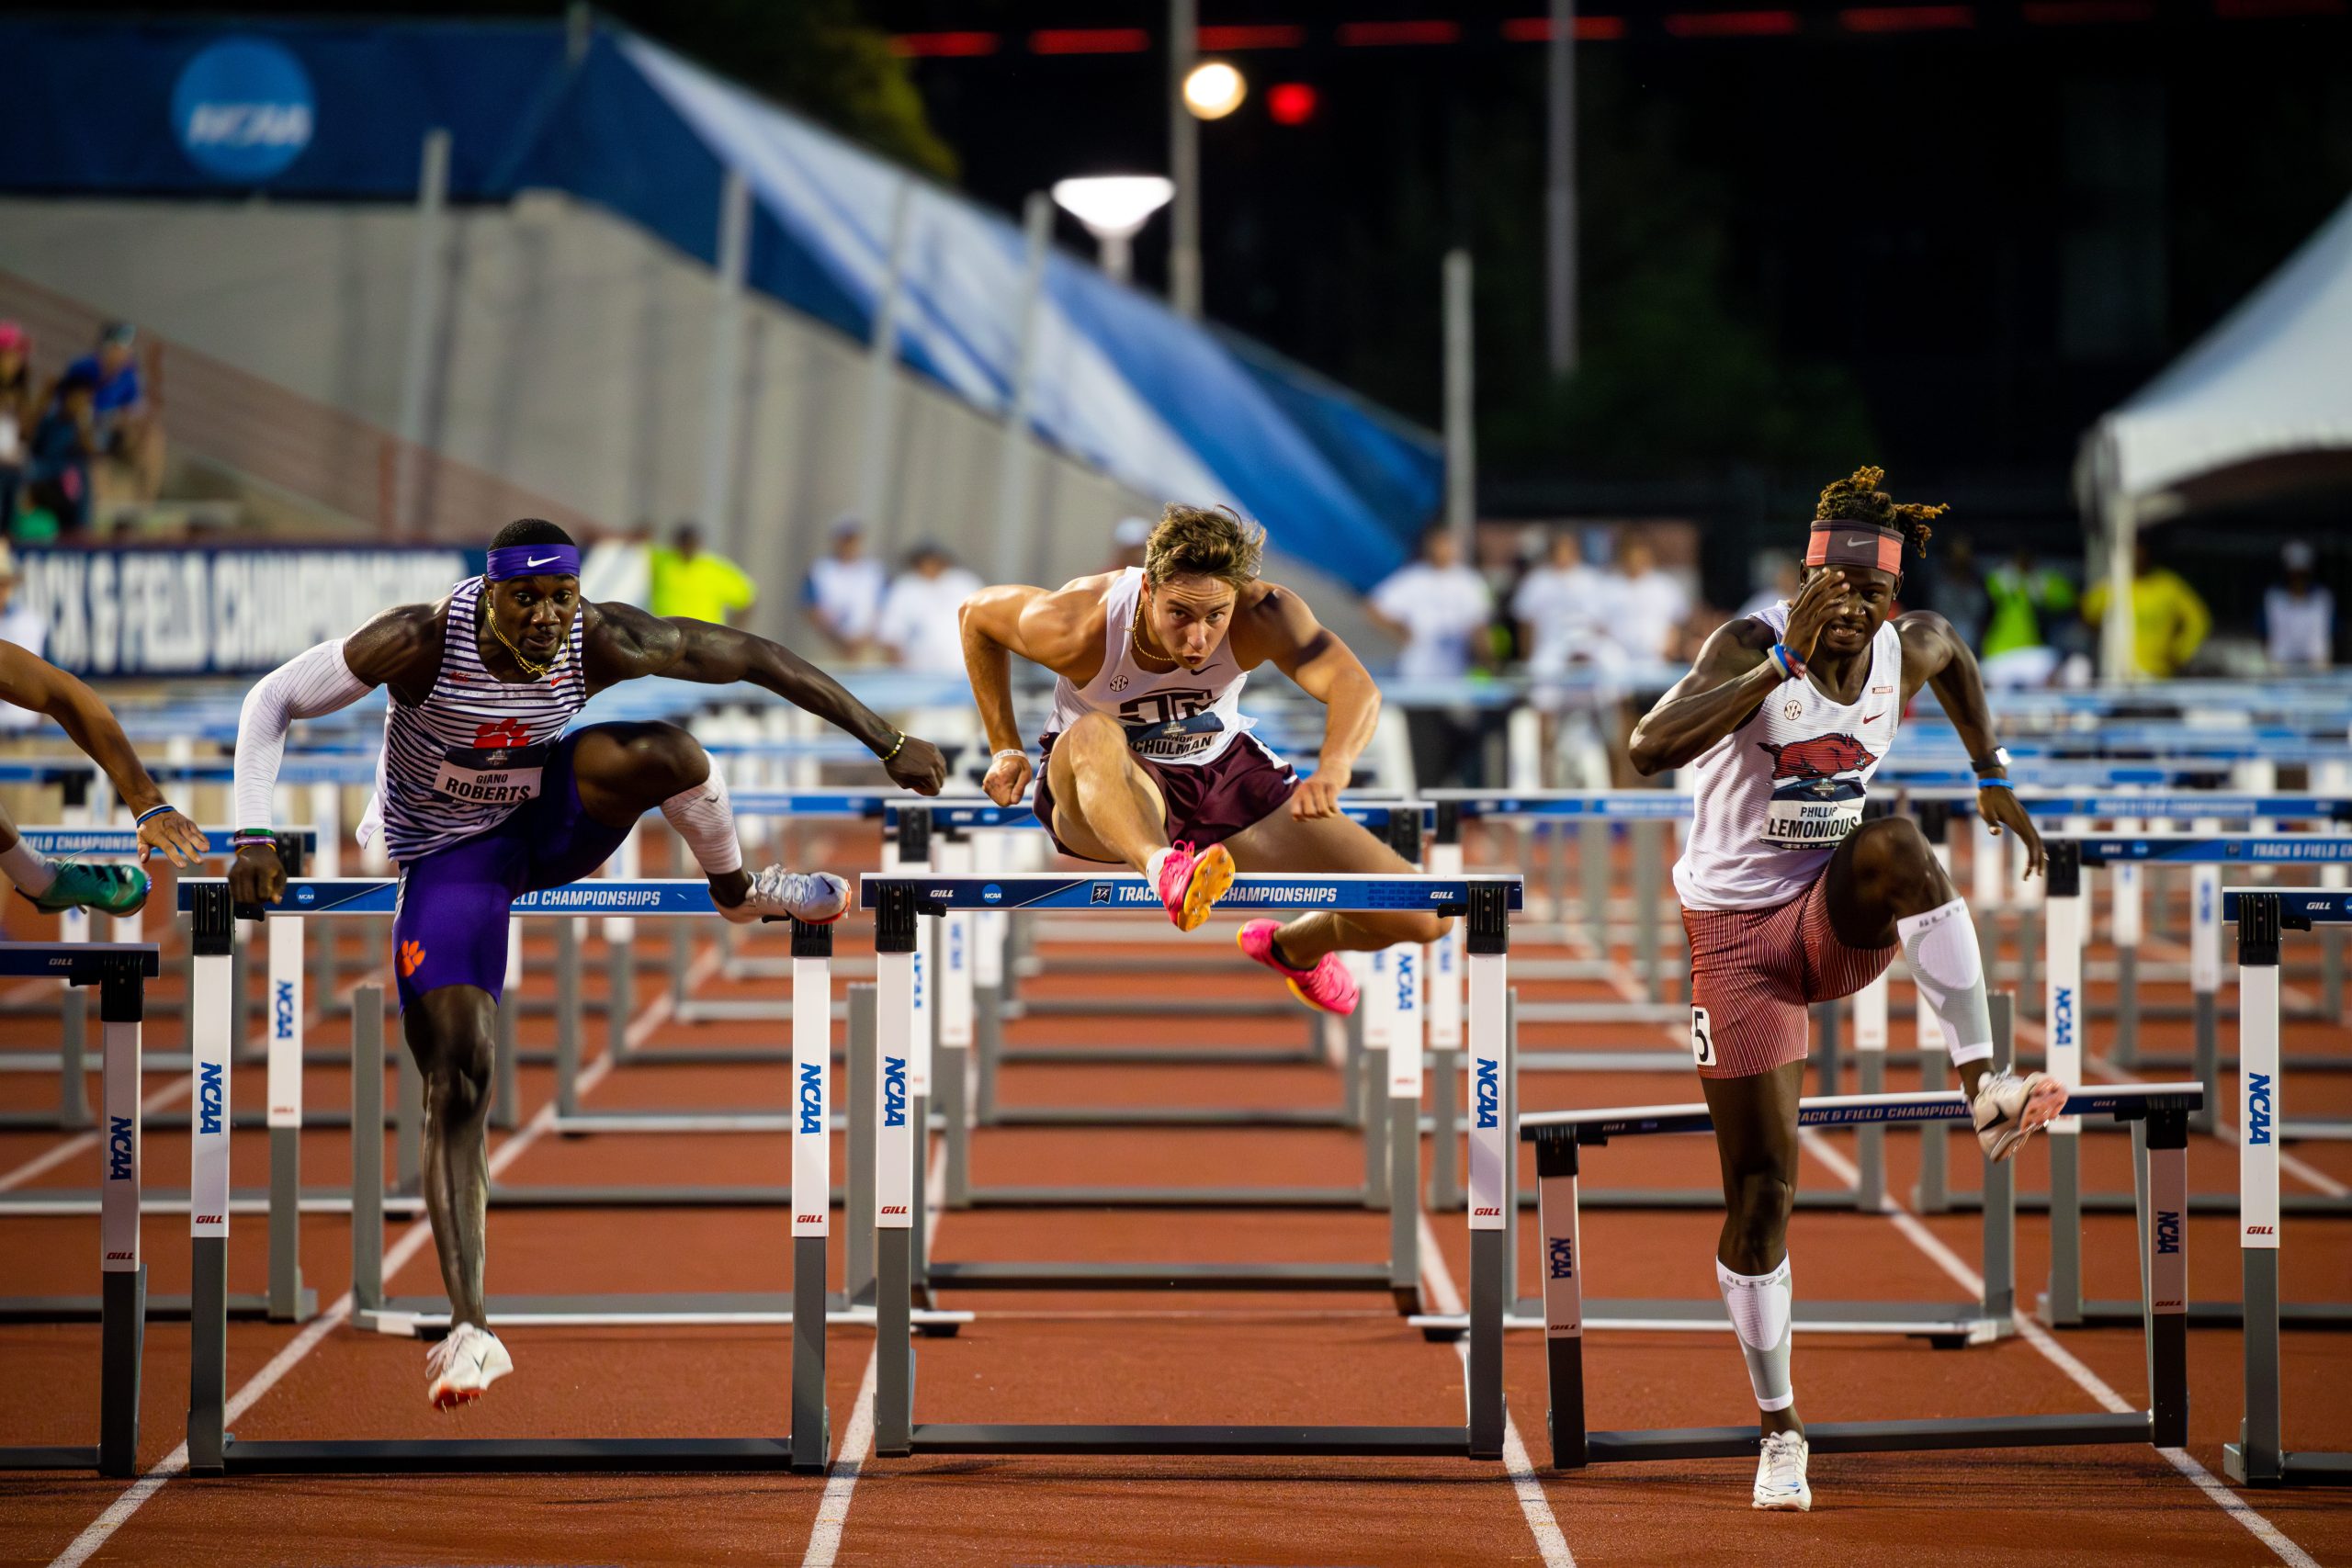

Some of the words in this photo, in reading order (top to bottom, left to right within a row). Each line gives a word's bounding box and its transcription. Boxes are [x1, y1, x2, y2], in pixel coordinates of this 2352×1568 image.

[1110, 675, 1128, 692] SEC
[1132, 736, 1213, 754] CHULMAN
[476, 774, 508, 784] GIANO
[445, 776, 530, 801] ROBERTS
[1800, 806, 1838, 818] PHILLIP
[1768, 816, 1858, 838] LEMONIOUS
[541, 891, 661, 906] CHAMPIONSHIPS
[930, 889, 954, 897] GILL
[1430, 891, 1453, 899] GILL
[2306, 901, 2331, 910] GILL
[1695, 1011, 1709, 1062] 5
[200, 1062, 221, 1134] NCAA
[800, 1063, 821, 1134] NCAA
[885, 1056, 906, 1127] NCAA
[1477, 1057, 1498, 1129] NCAA
[1798, 1111, 1829, 1122] ACK
[1844, 1108, 1883, 1120] FIELD
[1887, 1105, 1965, 1118] CHAMPION
[2249, 1072, 2270, 1145] NCAA
[110, 1116, 132, 1180] NCAA
[881, 1206, 907, 1214] GILL
[1474, 1208, 1500, 1216] GILL
[196, 1215, 223, 1224] GILL
[797, 1214, 823, 1224] GILL
[2157, 1211, 2179, 1254] NCAA
[2246, 1226, 2274, 1235] GILL
[1550, 1237, 1572, 1279] NCAA
